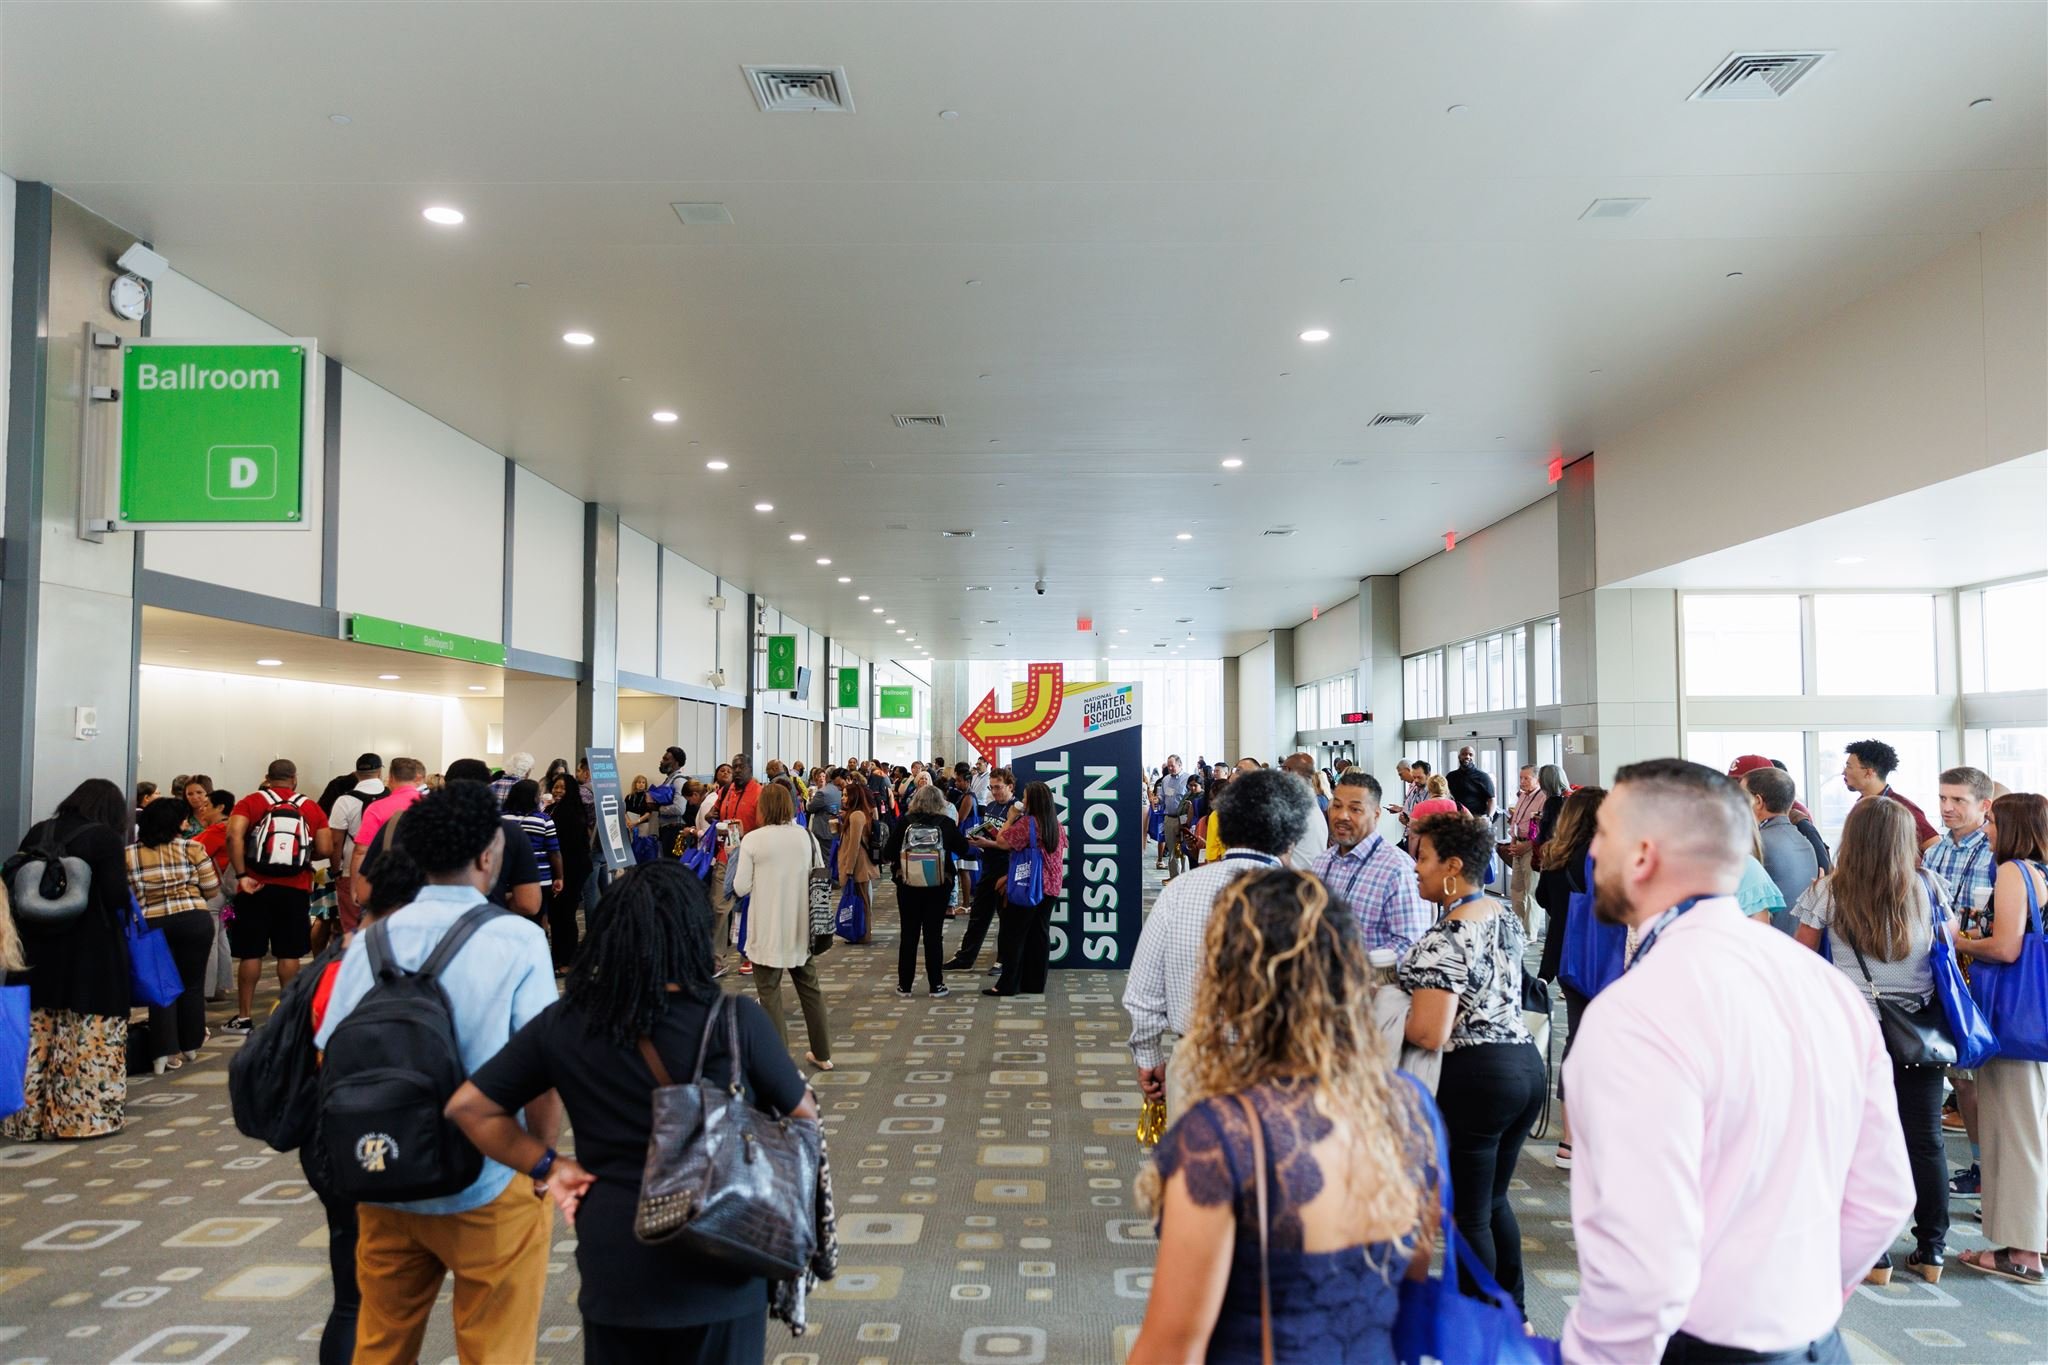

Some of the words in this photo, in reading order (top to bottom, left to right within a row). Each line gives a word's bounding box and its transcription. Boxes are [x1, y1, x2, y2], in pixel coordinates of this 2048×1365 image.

[138, 363, 280, 390] Ballroom
[229, 457, 259, 489] D
[423, 635, 449, 650] Ballroom
[449, 640, 455, 651] D
[1083, 692, 1112, 703] NATIONAL
[1084, 694, 1125, 715] CHARTER
[1090, 704, 1132, 725] SCHOOLS
[1099, 715, 1132, 728] CONFERENCE
[1083, 765, 1119, 962] SESSION
